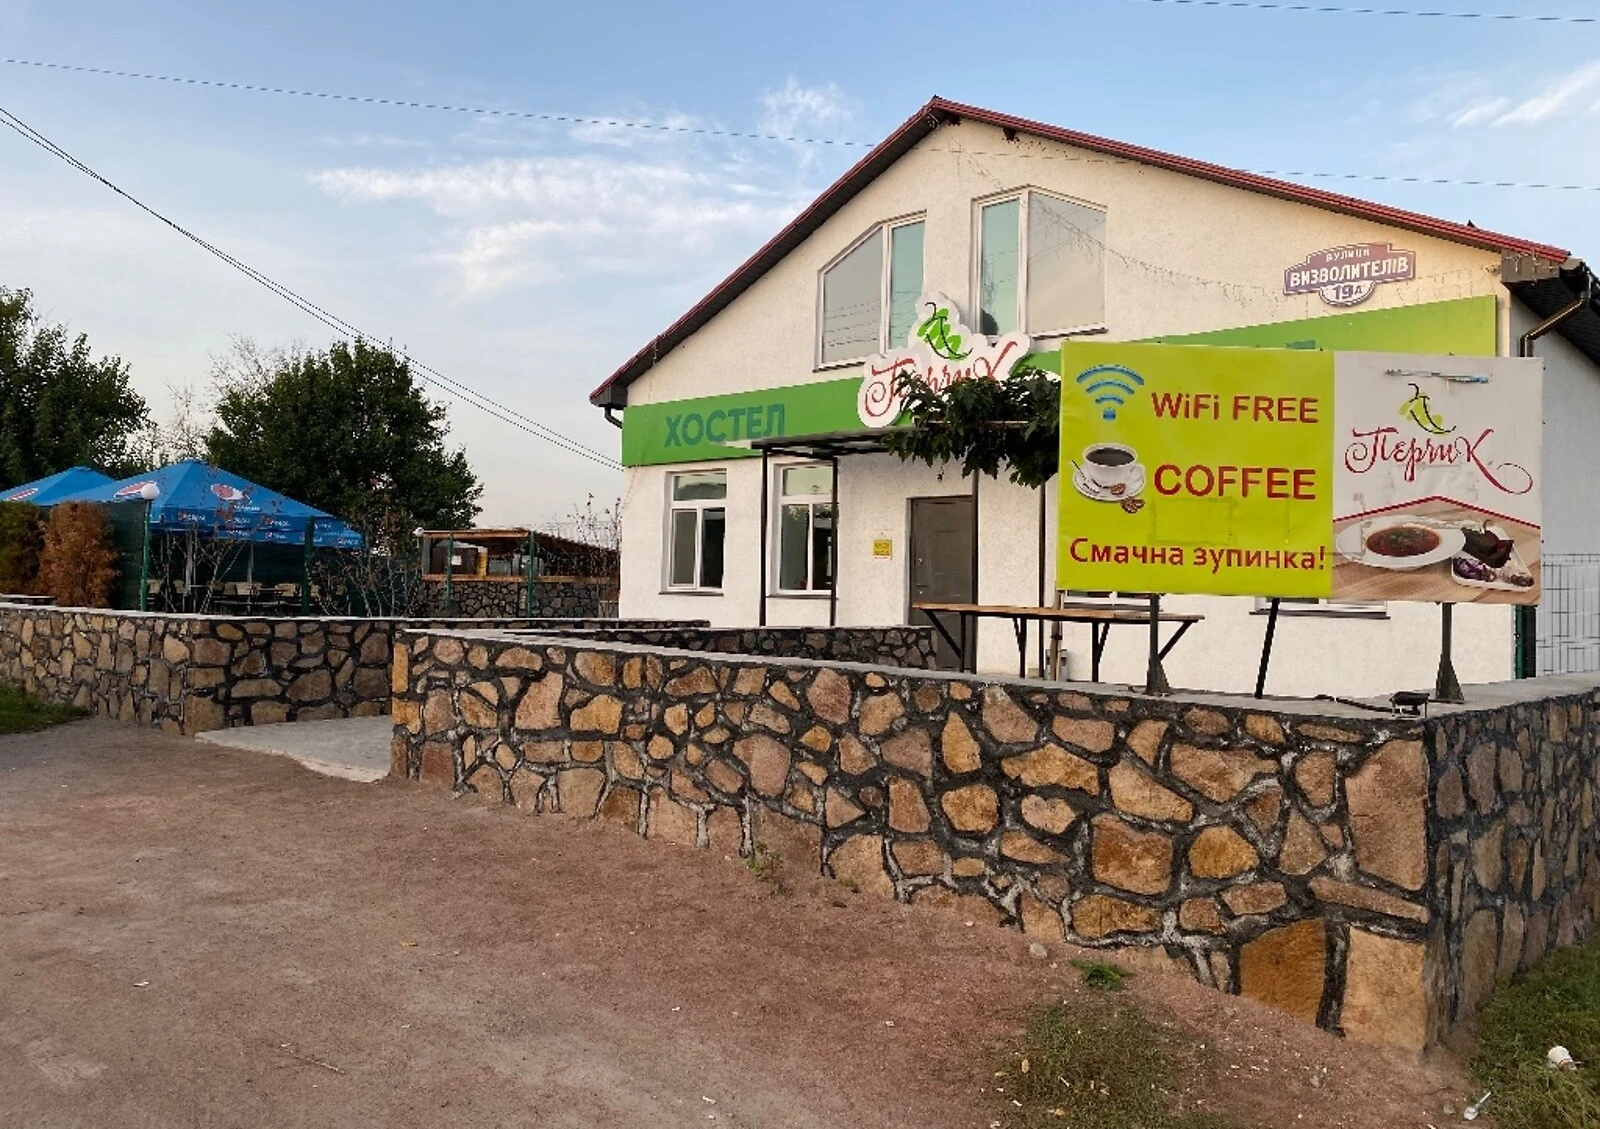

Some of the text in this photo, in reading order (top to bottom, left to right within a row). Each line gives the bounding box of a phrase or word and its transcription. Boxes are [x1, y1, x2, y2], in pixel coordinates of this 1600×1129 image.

[1290, 256, 1409, 288] ВИЗВОЛИТЕЛІВ
[664, 404, 785, 448] ХОСТЕЛ
[1151, 392, 1319, 424] WiFi FREE
[1154, 464, 1317, 500] COFFEE
[1069, 537, 1326, 574] Смачна зупинка!
